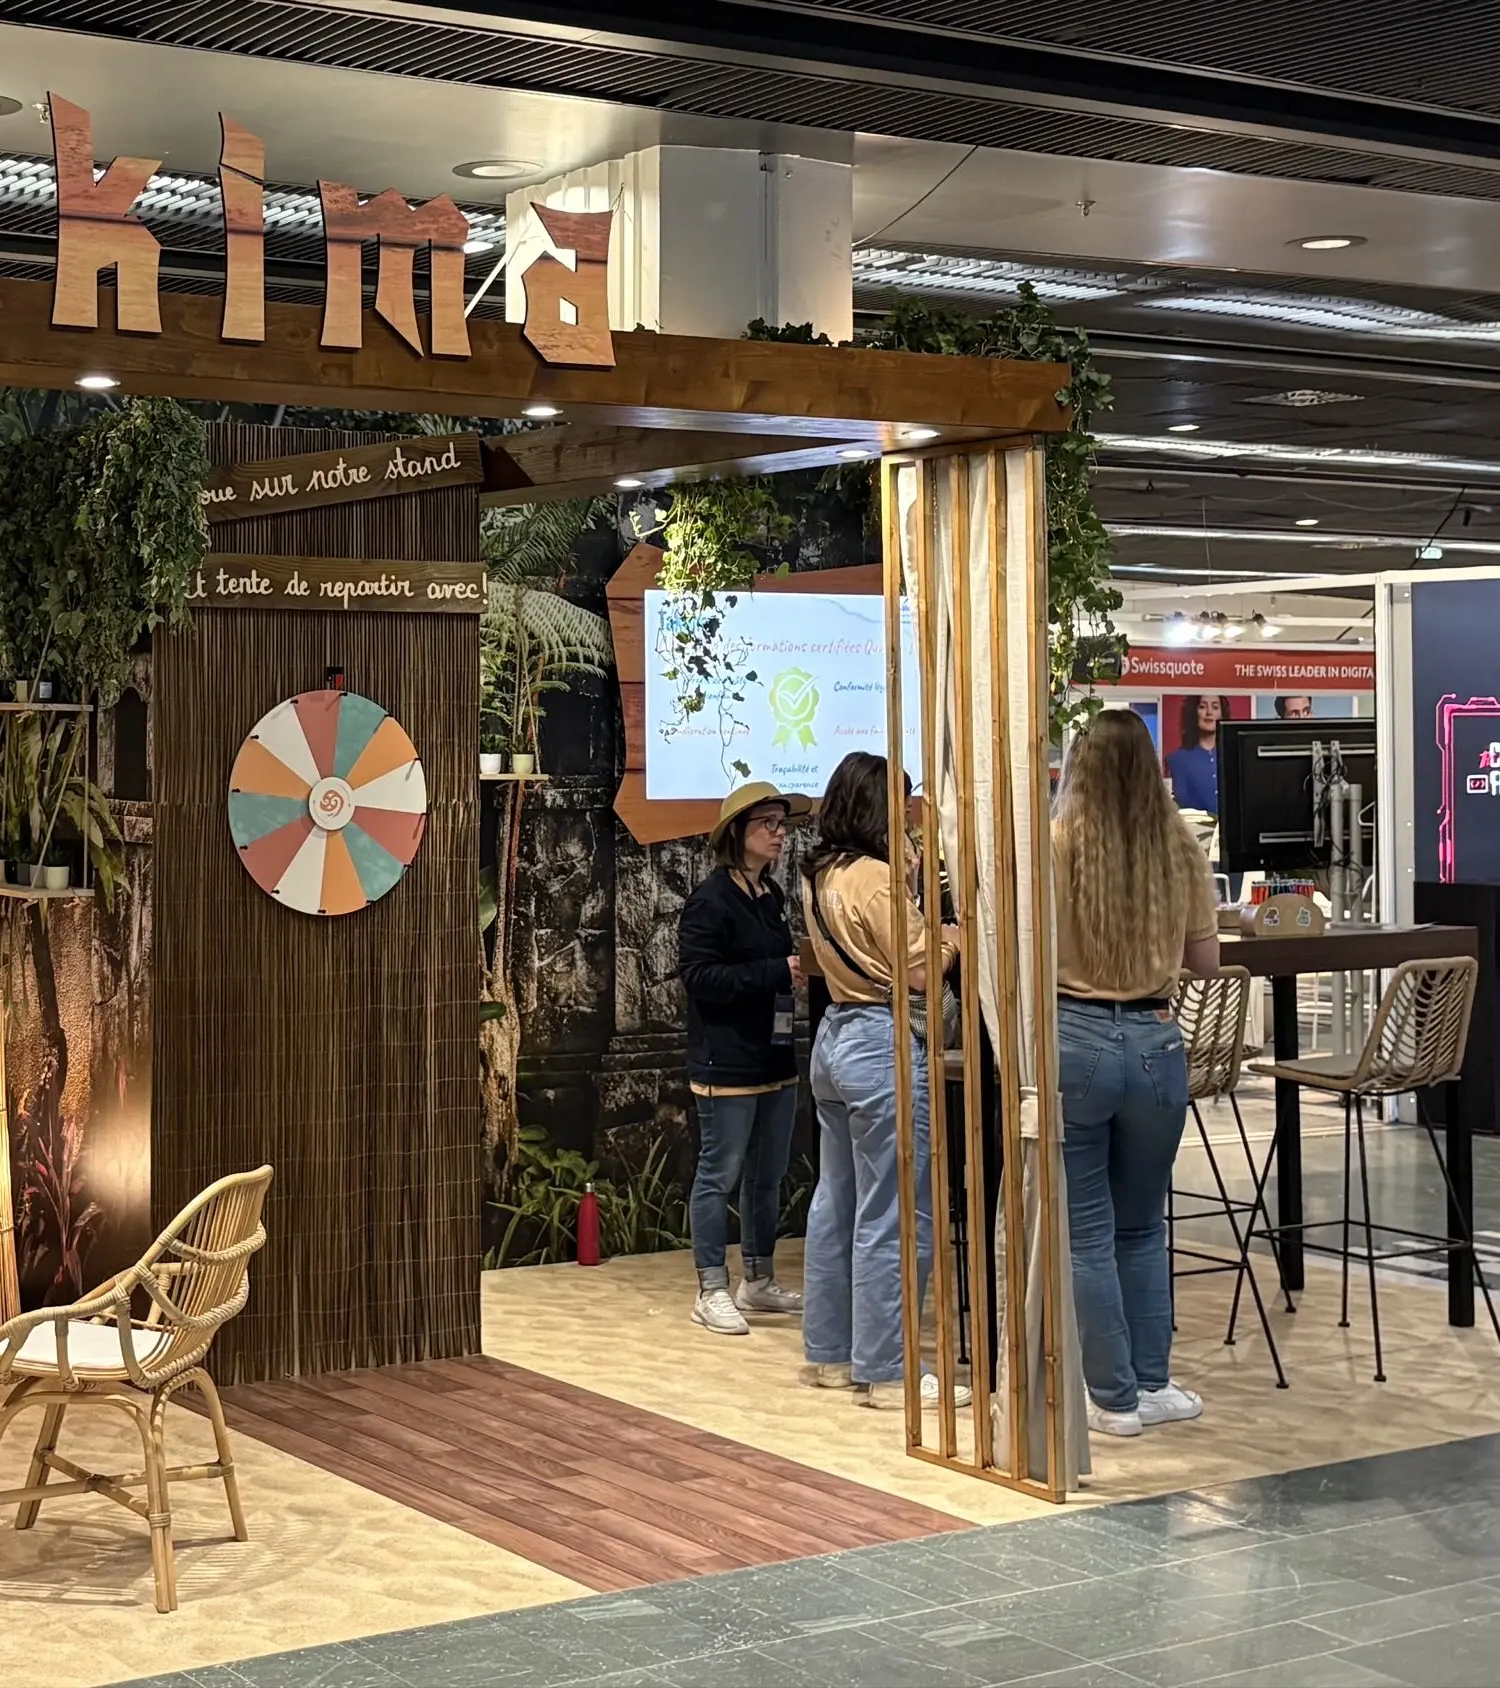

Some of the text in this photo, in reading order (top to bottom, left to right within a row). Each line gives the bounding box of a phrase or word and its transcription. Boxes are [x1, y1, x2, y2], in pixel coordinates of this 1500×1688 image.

[200, 441, 462, 505] oue sur notre stand
[215, 567, 274, 596] tente
[284, 571, 311, 596] de
[319, 573, 415, 610] repartir
[426, 571, 489, 604] avec!
[1131, 656, 1374, 679] Swissquote THE SWISS LEADER IN DIGITA
